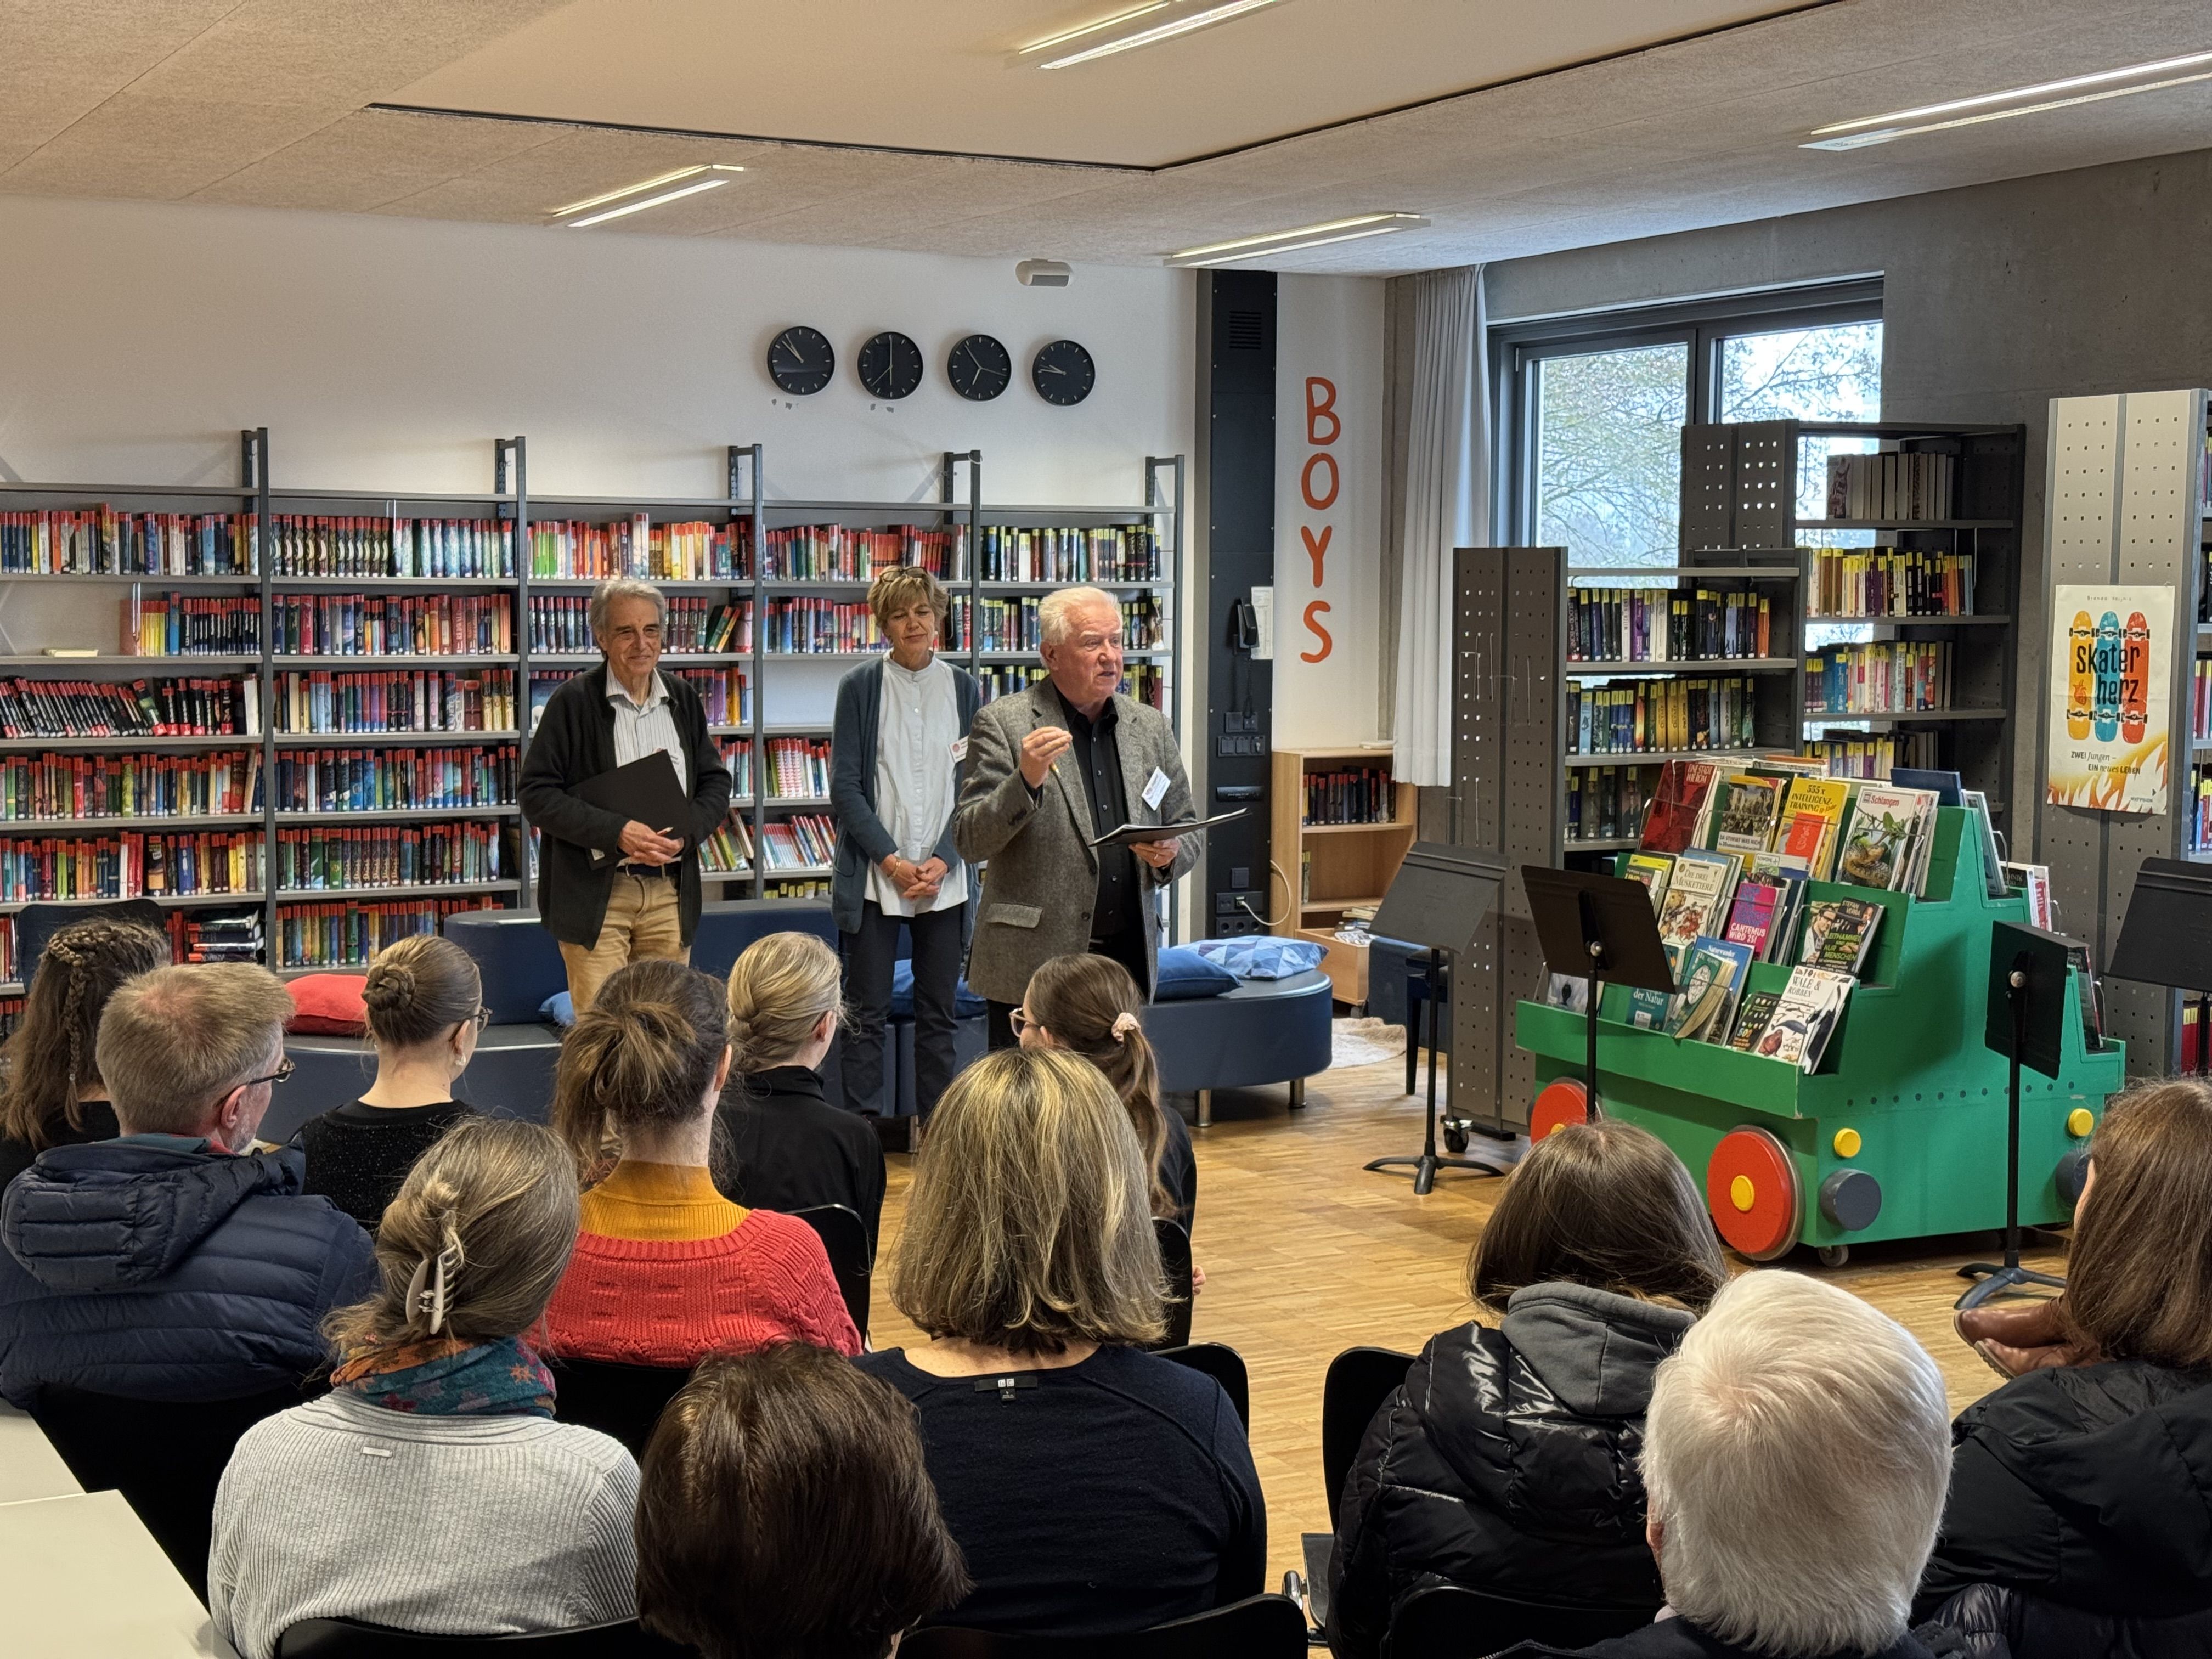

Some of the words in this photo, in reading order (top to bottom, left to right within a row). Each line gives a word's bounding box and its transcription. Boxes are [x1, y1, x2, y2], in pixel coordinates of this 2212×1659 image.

[1300, 377, 1341, 663] BOYS
[2076, 643, 2140, 674] skater
[2097, 674, 2139, 705] herz
[2087, 752, 2110, 763] Jungen
[1697, 764, 1712, 774] STADT
[2120, 766, 2140, 775] LEBEN
[1807, 785, 1820, 793] 555
[1791, 793, 1833, 805] INTELLIGENZ-
[1870, 795, 1899, 808] Schlangen
[1790, 801, 1819, 812] TRAINING
[1684, 868, 1695, 877] DIE
[1696, 872, 1708, 881] DREI
[1675, 876, 1714, 891] MUSKETIERE
[1730, 922, 1766, 937] CANTEMUS
[1748, 934, 1757, 944] 25!
[1824, 951, 1858, 961] MENSCHEN
[1792, 976, 1813, 989] WALE
[1814, 982, 1821, 991] &
[1633, 989, 1644, 1000] der
[1645, 993, 1663, 1006] Natur
[1787, 987, 1813, 997] ROBBEN
